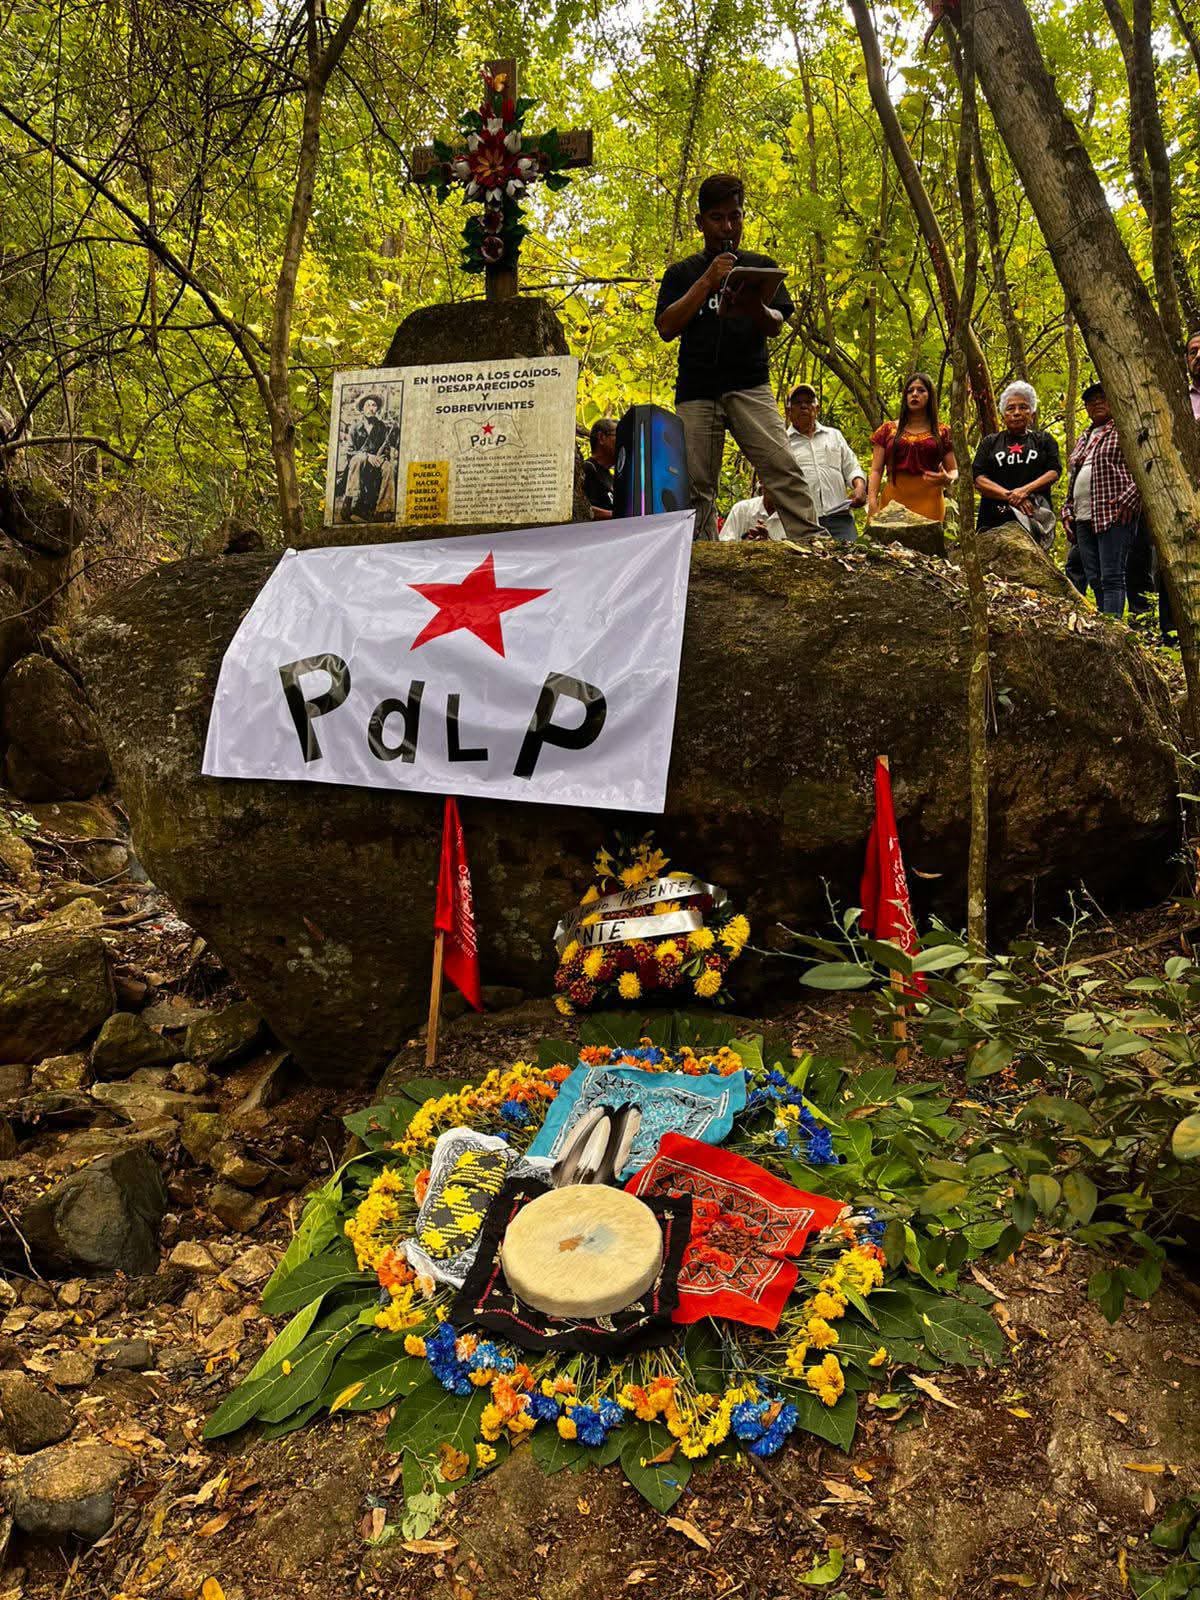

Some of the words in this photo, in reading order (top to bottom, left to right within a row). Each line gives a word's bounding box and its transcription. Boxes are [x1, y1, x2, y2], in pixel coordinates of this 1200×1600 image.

[413, 377, 428, 385] EN
[432, 374, 473, 383] HONOR
[476, 373, 484, 381] A
[488, 371, 510, 380] LOS
[513, 367, 561, 378] CAÍDOS,
[437, 380, 535, 393] DESAPARECIDOS
[482, 393, 489, 401] Y
[435, 400, 535, 414] SOBREVIVIENTES
[470, 434, 506, 447] PdLP
[995, 449, 1038, 467] PdLP
[278, 652, 608, 781] PdLP
[619, 879, 695, 907] PRESENTE!
